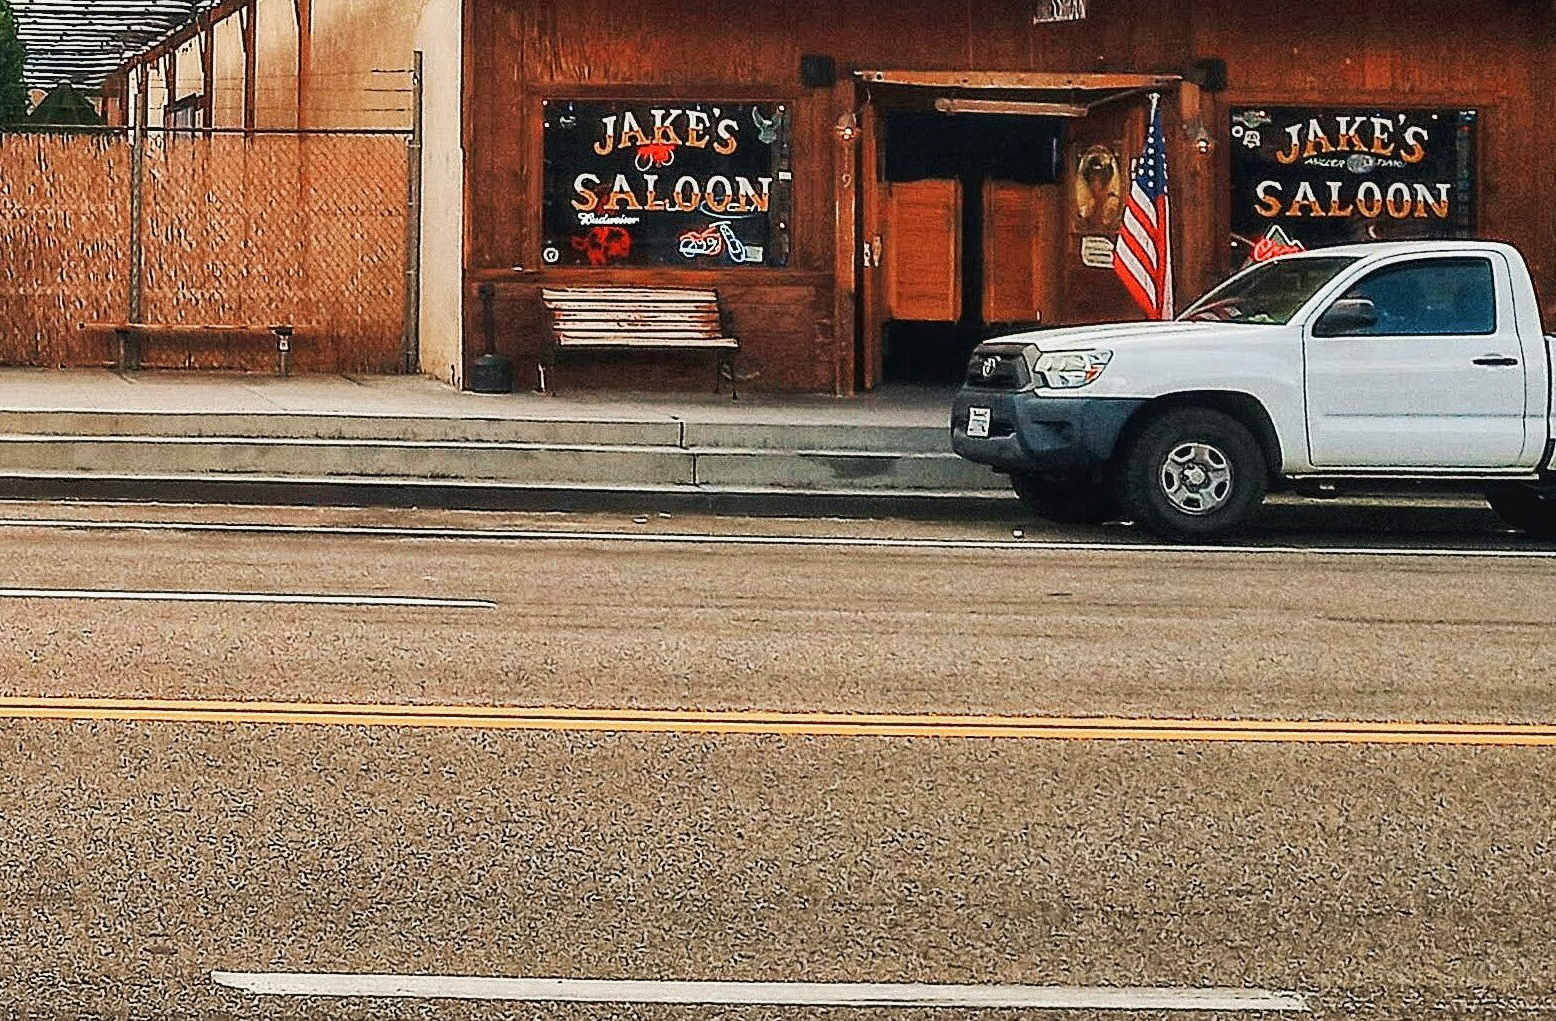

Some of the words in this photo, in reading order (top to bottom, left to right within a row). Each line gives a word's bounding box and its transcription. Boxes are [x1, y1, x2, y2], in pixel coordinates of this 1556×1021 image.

[594, 107, 739, 155] JAKE'S
[1276, 114, 1428, 164] JAKE'S
[571, 173, 772, 212] SALOON
[1254, 180, 1451, 219] SALOON
